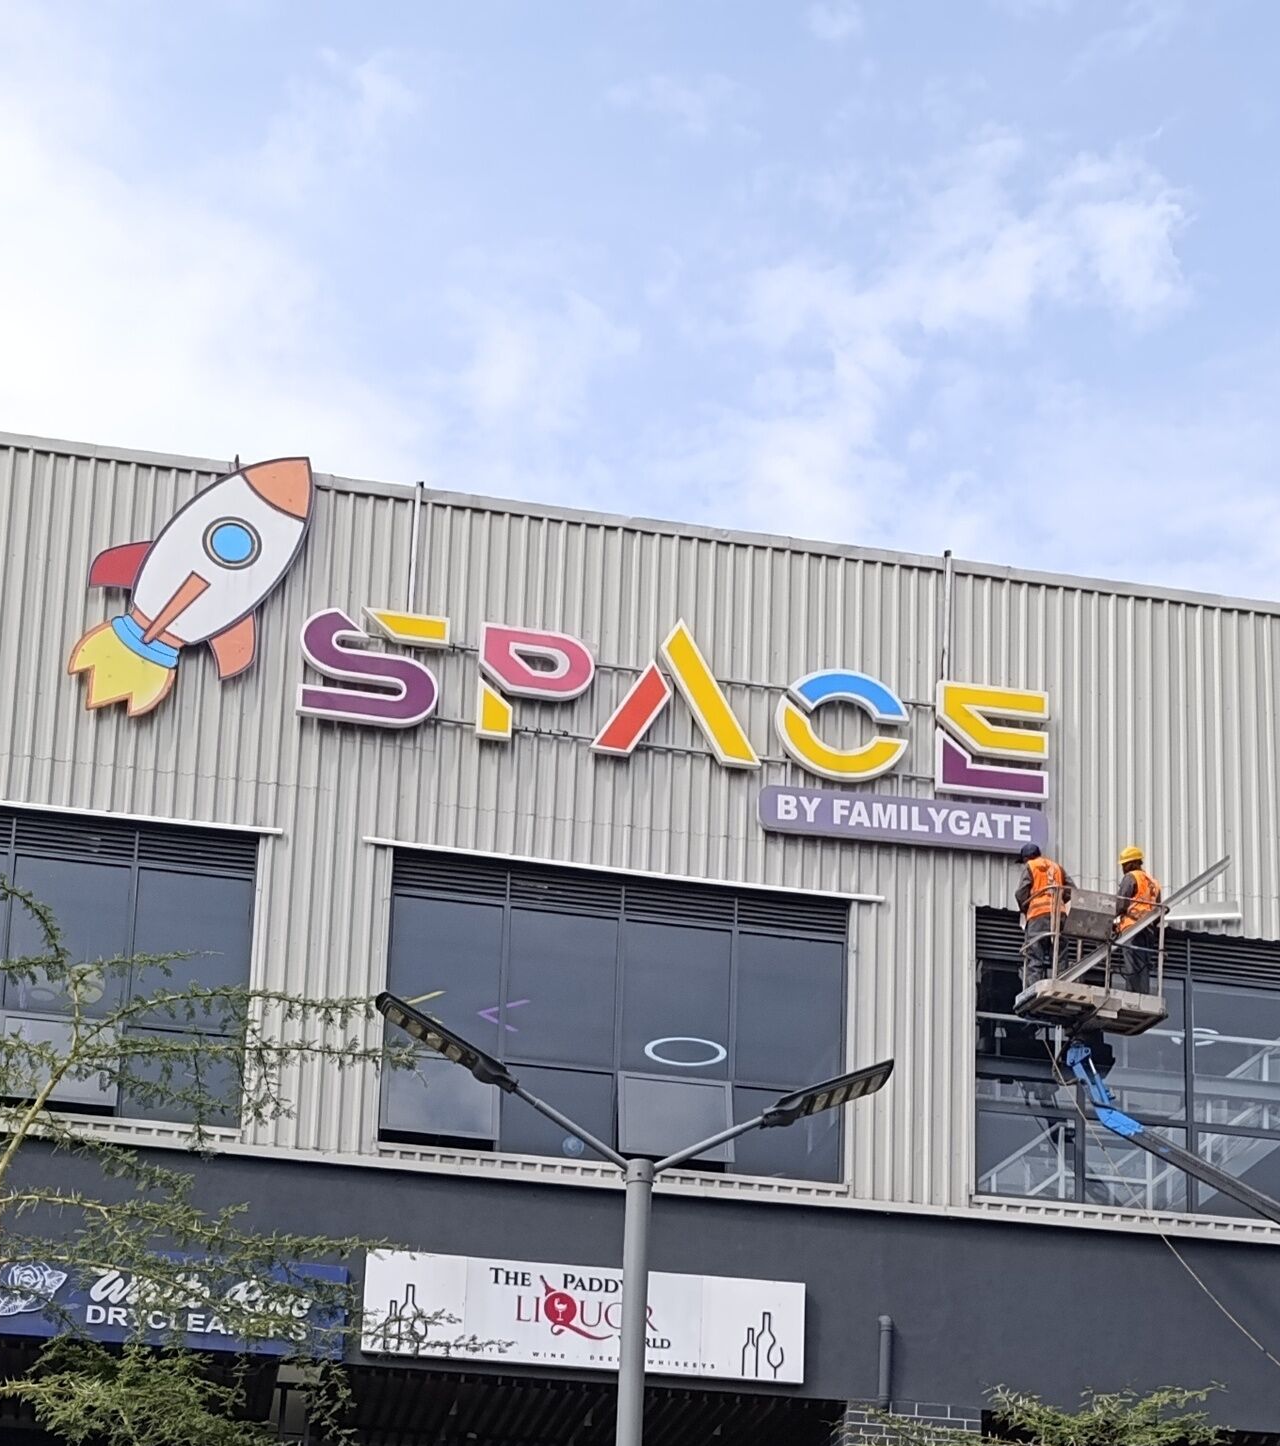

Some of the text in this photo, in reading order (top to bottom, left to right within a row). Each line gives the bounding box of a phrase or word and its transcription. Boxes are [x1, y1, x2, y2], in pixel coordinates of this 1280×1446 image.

[296, 606, 1050, 800] SPACE
[776, 794, 1032, 843] BY FAMILYGATE
[490, 1267, 623, 1294] THE PADD
